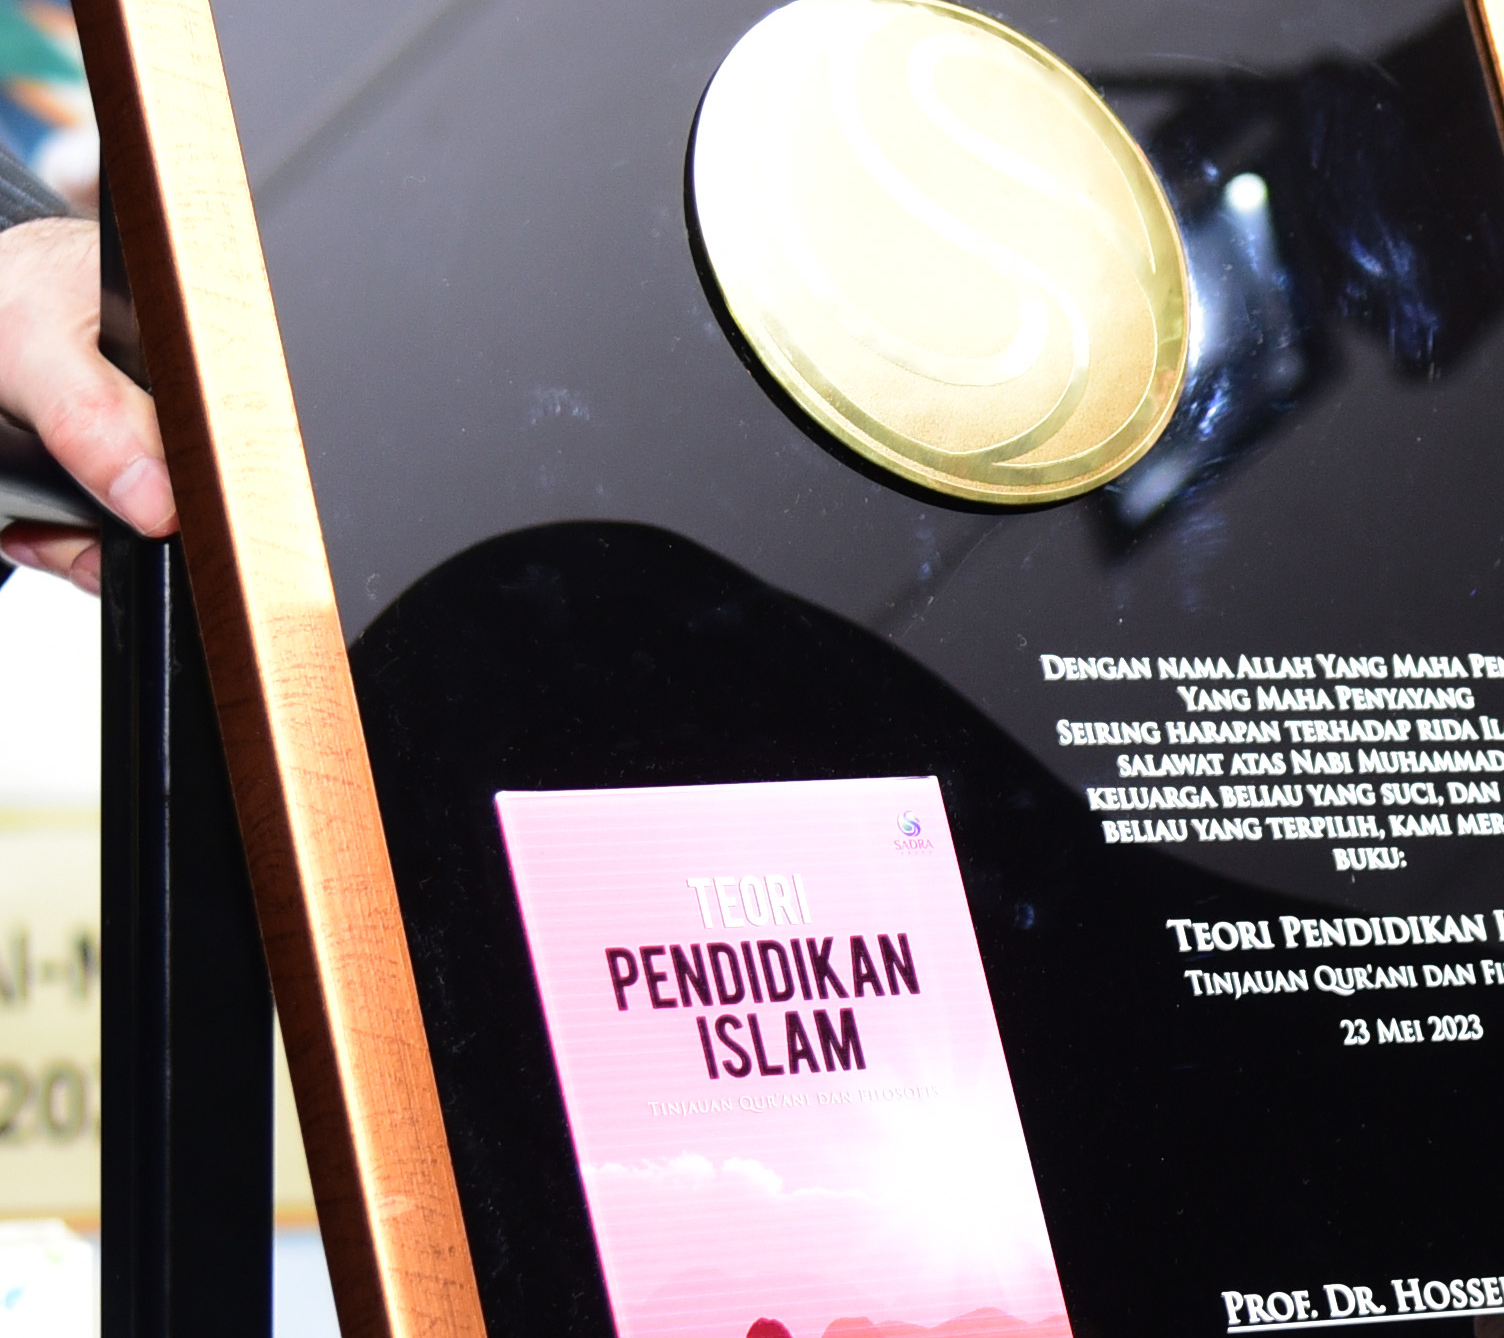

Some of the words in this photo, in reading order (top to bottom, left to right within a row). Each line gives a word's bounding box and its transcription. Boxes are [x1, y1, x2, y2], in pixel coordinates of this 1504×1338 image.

[1040, 655, 1152, 680] DENGAN
[1158, 657, 1235, 679] NAMA
[1237, 654, 1315, 679] ALLAH
[1315, 655, 1389, 678] YANG
[1393, 654, 1468, 678] MAHA
[1177, 686, 1251, 711] YANG
[1257, 685, 1334, 711] MAHA
[1335, 685, 1475, 709] PENYAYANG
[1057, 719, 1161, 745] SEIRING
[1166, 721, 1281, 744] HARAPAN
[1284, 720, 1411, 742] TERHADAP
[1416, 718, 1479, 741] RIDA
[1117, 754, 1224, 777] SALAWAT
[1231, 753, 1286, 775] ATAS
[1291, 749, 1353, 774] NABI
[1087, 786, 1218, 810] KELUARGA
[1219, 785, 1303, 808] BELIAU
[1306, 783, 1376, 806] YANG
[1381, 783, 1444, 806] SUCI,
[1447, 782, 1500, 804] DAN
[1102, 819, 1188, 843] BELIAU
[1191, 818, 1262, 841] YANG
[1265, 816, 1385, 839] TERPILIH,
[1388, 814, 1453, 837] KAMI
[894, 839, 935, 851] SADRA
[1333, 847, 1407, 870] BUKU:
[686, 873, 812, 929] TEORI
[1166, 919, 1274, 951] TEORI
[1279, 914, 1487, 948] PENDIDIKAN
[605, 932, 920, 1012] PENDIDIKAN
[1185, 970, 1308, 999] TINJAUAN
[1423, 964, 1476, 987] DAN
[696, 1007, 867, 1080] ISLAM
[1340, 1019, 1370, 1045] 23
[1377, 1018, 1424, 1043] MEI
[1428, 1014, 1483, 1041] 2023
[648, 1099, 733, 1117] TINJAUAN
[817, 1090, 852, 1105] DAN
[1221, 1290, 1318, 1325] PROF.
[1323, 1283, 1387, 1318] DR.
